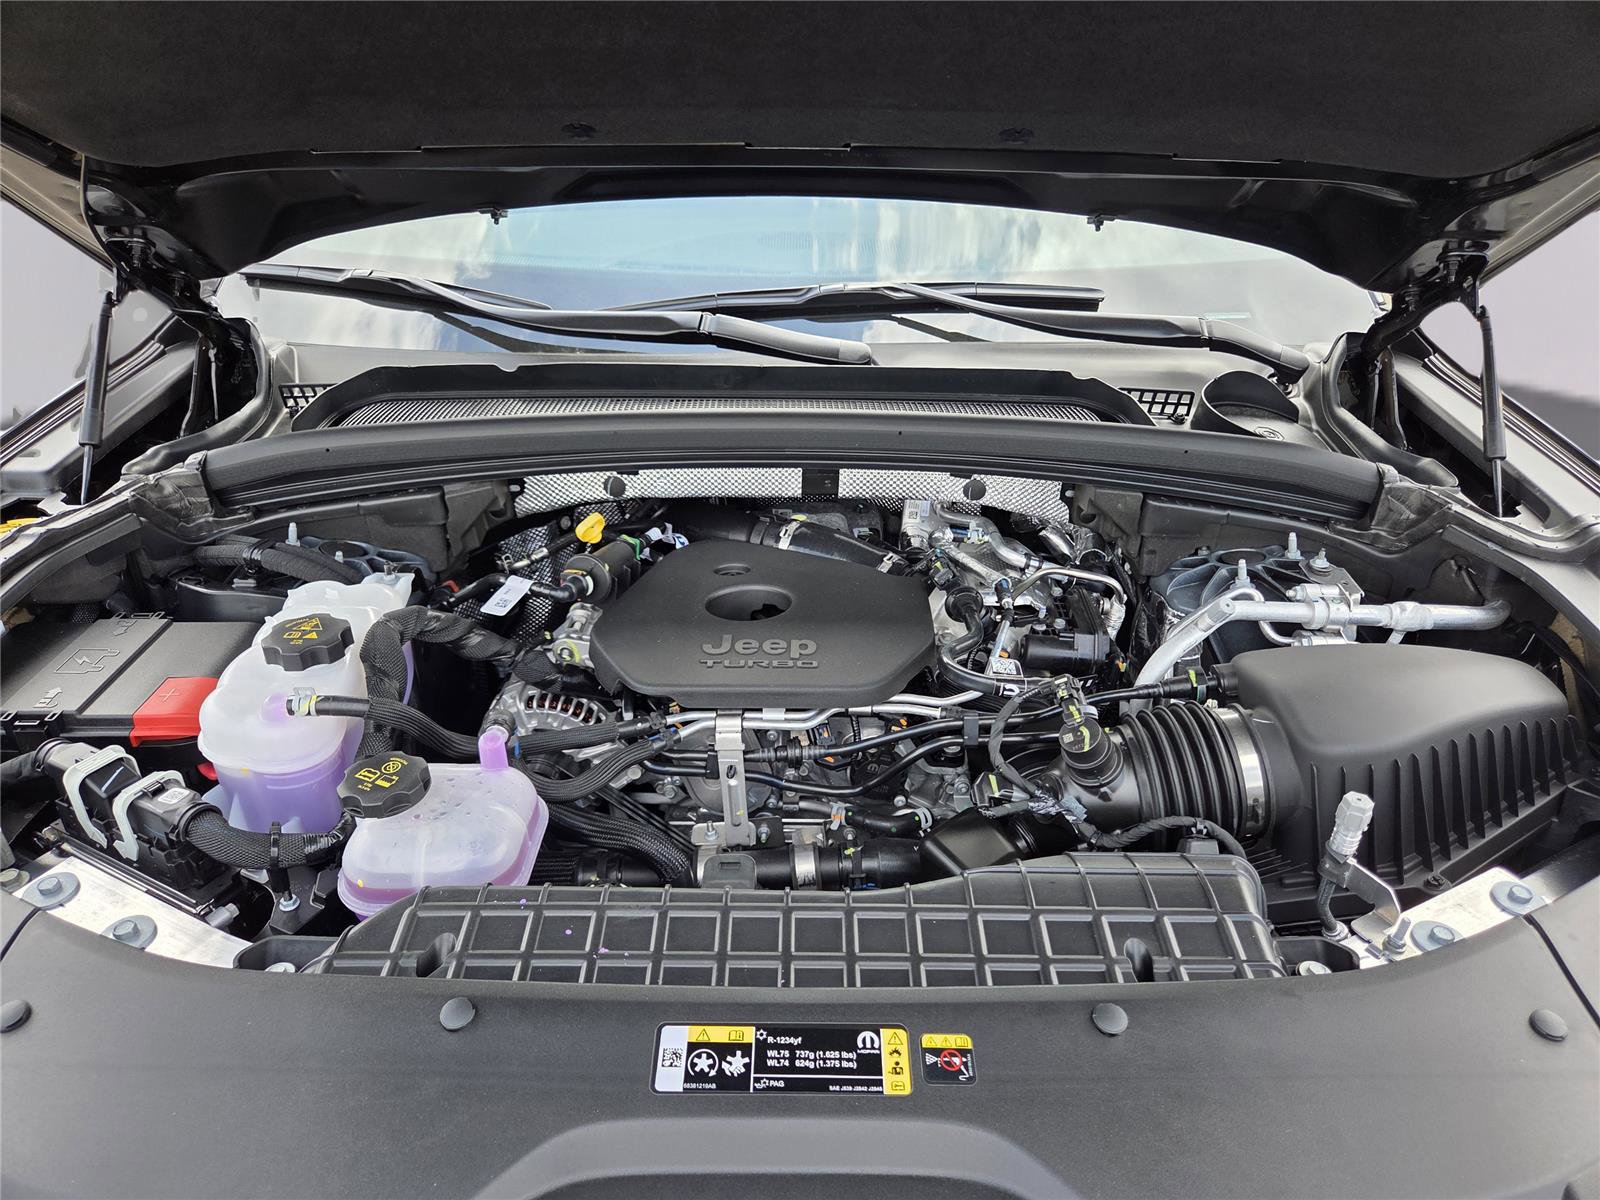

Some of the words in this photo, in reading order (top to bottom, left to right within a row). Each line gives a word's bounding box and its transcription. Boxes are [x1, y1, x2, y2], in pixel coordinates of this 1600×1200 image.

[701, 633, 818, 660] Jeep
[698, 659, 820, 669] TURBO
[767, 1036, 803, 1046] R-1234yf
[766, 1049, 790, 1058] WL75
[795, 1049, 815, 1060] 737g
[815, 1050, 841, 1060] (1.625
[841, 1051, 857, 1060] lbs)
[766, 1058, 790, 1067] WL74
[794, 1059, 815, 1069] 624g
[815, 1060, 841, 1069] (1.375
[841, 1060, 857, 1069] lbs)
[769, 1080, 785, 1088] PAG
